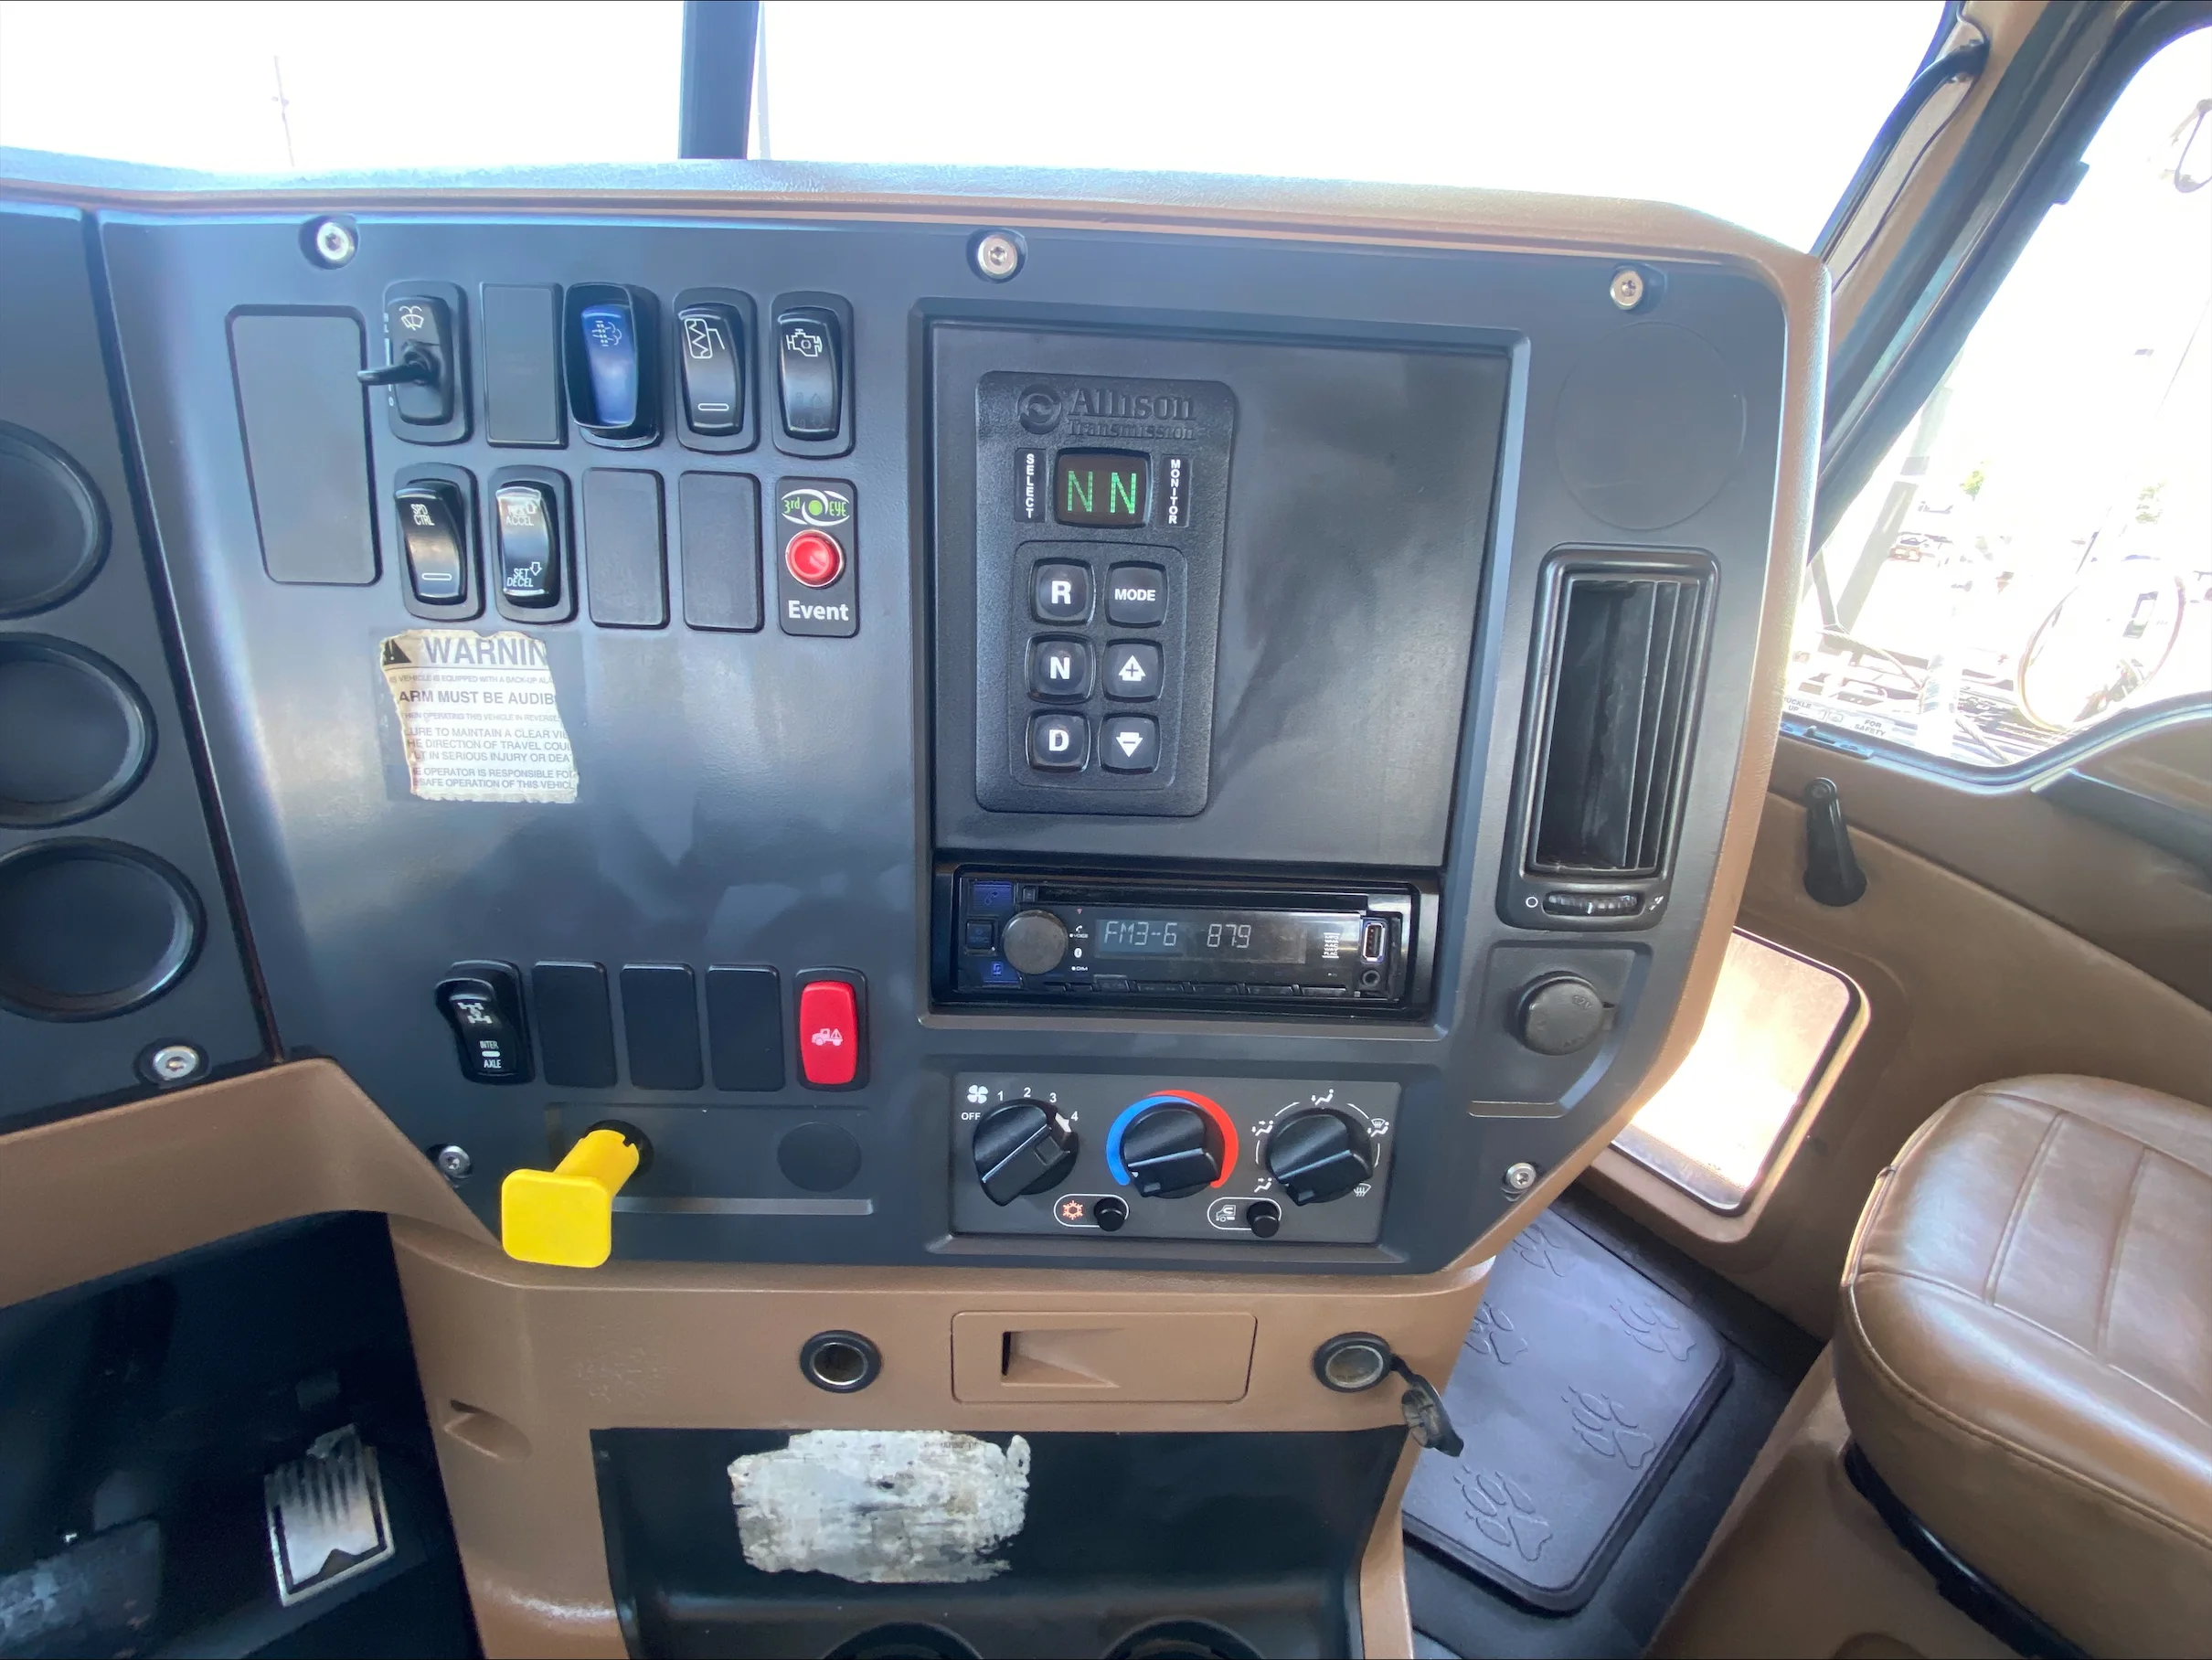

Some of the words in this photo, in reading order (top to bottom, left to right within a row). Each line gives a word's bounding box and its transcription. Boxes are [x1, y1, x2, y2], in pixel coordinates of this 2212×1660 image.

[1069, 388, 1196, 421] Allison
[1069, 418, 1196, 441] Transmission
[1026, 452, 1035, 519] SELECT
[1067, 470, 1093, 513] N
[1110, 472, 1137, 515] N
[1168, 459, 1181, 525] MONITOR
[410, 503, 429, 515] SPD
[783, 496, 801, 515] 3rd
[413, 515, 435, 527] CTRL
[505, 515, 535, 527] ACCEL
[513, 568, 530, 579] SET
[506, 577, 534, 588] DECEL
[1051, 580, 1072, 605] R
[1113, 588, 1156, 601] MODE
[788, 600, 849, 622] Event
[1049, 655, 1070, 680] N
[438, 690, 478, 704] MUST
[483, 691, 504, 705] BE
[1854, 723, 1887, 737] SAFETY
[1865, 719, 1882, 729] FOR
[435, 728, 450, 737] TO
[452, 728, 503, 739] MAINTAIN
[504, 729, 513, 738] A
[514, 729, 550, 740] CLEAR
[425, 739, 482, 750] DIRECTION
[483, 740, 498, 750] OF
[500, 740, 542, 750] TRAVEL
[1048, 729, 1069, 752] D
[429, 750, 440, 760] IN
[441, 750, 487, 761] SERIOUS
[489, 752, 528, 762] INJURY
[529, 753, 547, 762] OR
[548, 753, 572, 763] DEA
[423, 767, 476, 777] OPERATOR
[477, 768, 487, 777] IS
[488, 769, 555, 779] RESPONSIBLE
[419, 778, 443, 787] SAFE
[445, 779, 500, 788] OPERATION
[501, 780, 516, 788] OF
[516, 780, 538, 789] THIS
[479, 1040, 499, 1049] INTER
[484, 1059, 502, 1069] AXLE
[997, 1091, 1004, 1101] 1
[1023, 1087, 1032, 1098] 2
[1049, 1092, 1058, 1103] 3
[961, 1112, 981, 1121] OFF
[1070, 1111, 1079, 1122] 4
